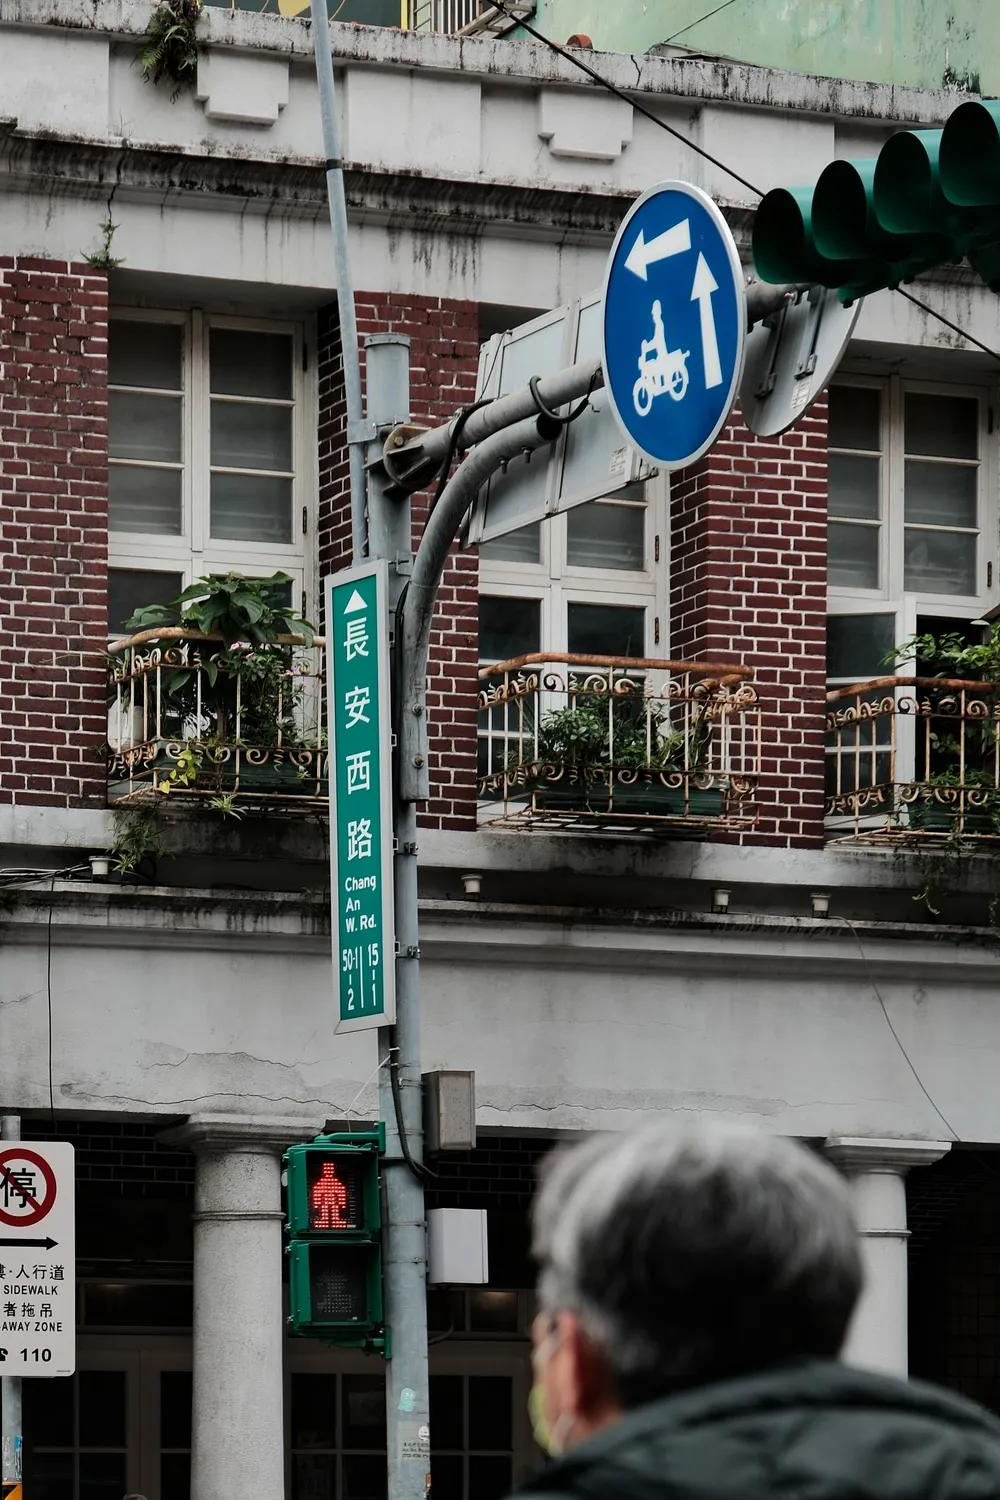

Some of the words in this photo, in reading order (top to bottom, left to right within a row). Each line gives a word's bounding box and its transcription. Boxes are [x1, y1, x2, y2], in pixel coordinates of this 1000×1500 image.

[343, 616, 373, 861] 長安西路
[345, 875, 377, 892] Chang
[345, 897, 361, 913] An
[345, 917, 358, 934] W.
[359, 914, 377, 930] Rd.
[368, 942, 379, 967] 15
[347, 987, 355, 1011] 2
[3, 1285, 58, 1296] SIDEWALK
[34, 1321, 63, 1332] ZONE
[20, 1348, 52, 1362] 110
